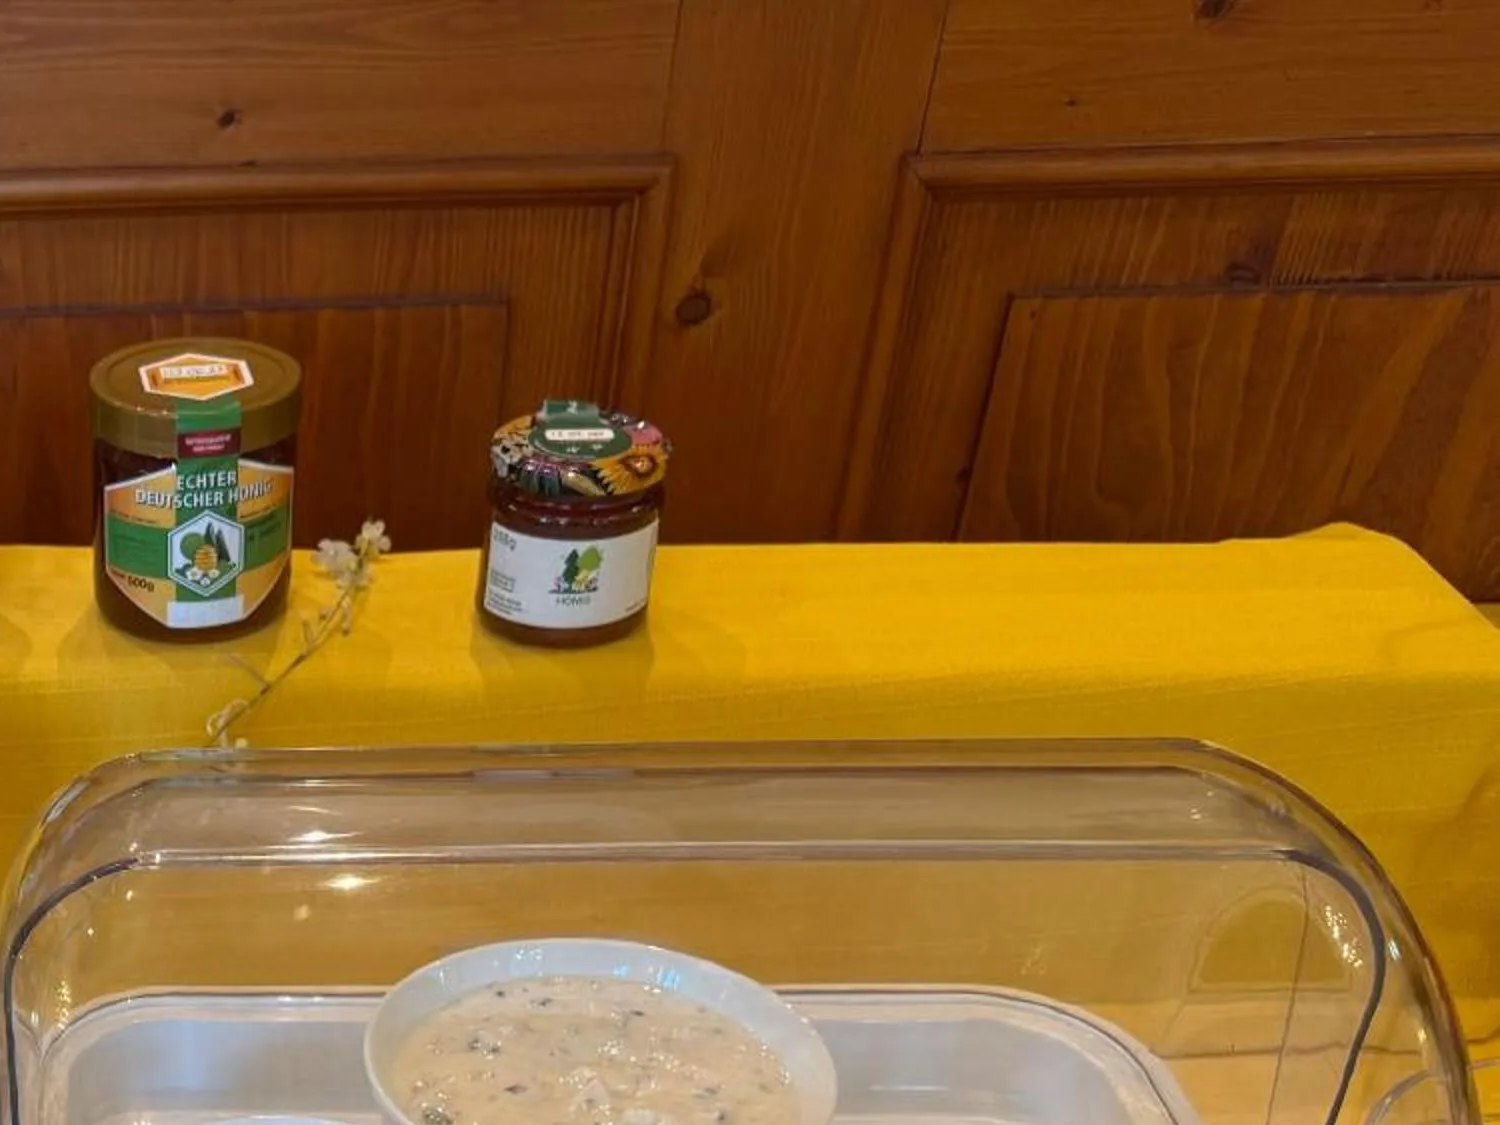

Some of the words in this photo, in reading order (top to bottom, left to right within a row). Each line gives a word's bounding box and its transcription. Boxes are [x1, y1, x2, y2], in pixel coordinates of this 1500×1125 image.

[177, 470, 237, 490] ECHTER
[135, 488, 224, 509] DEUTSCHER
[228, 480, 274, 504] HONIG
